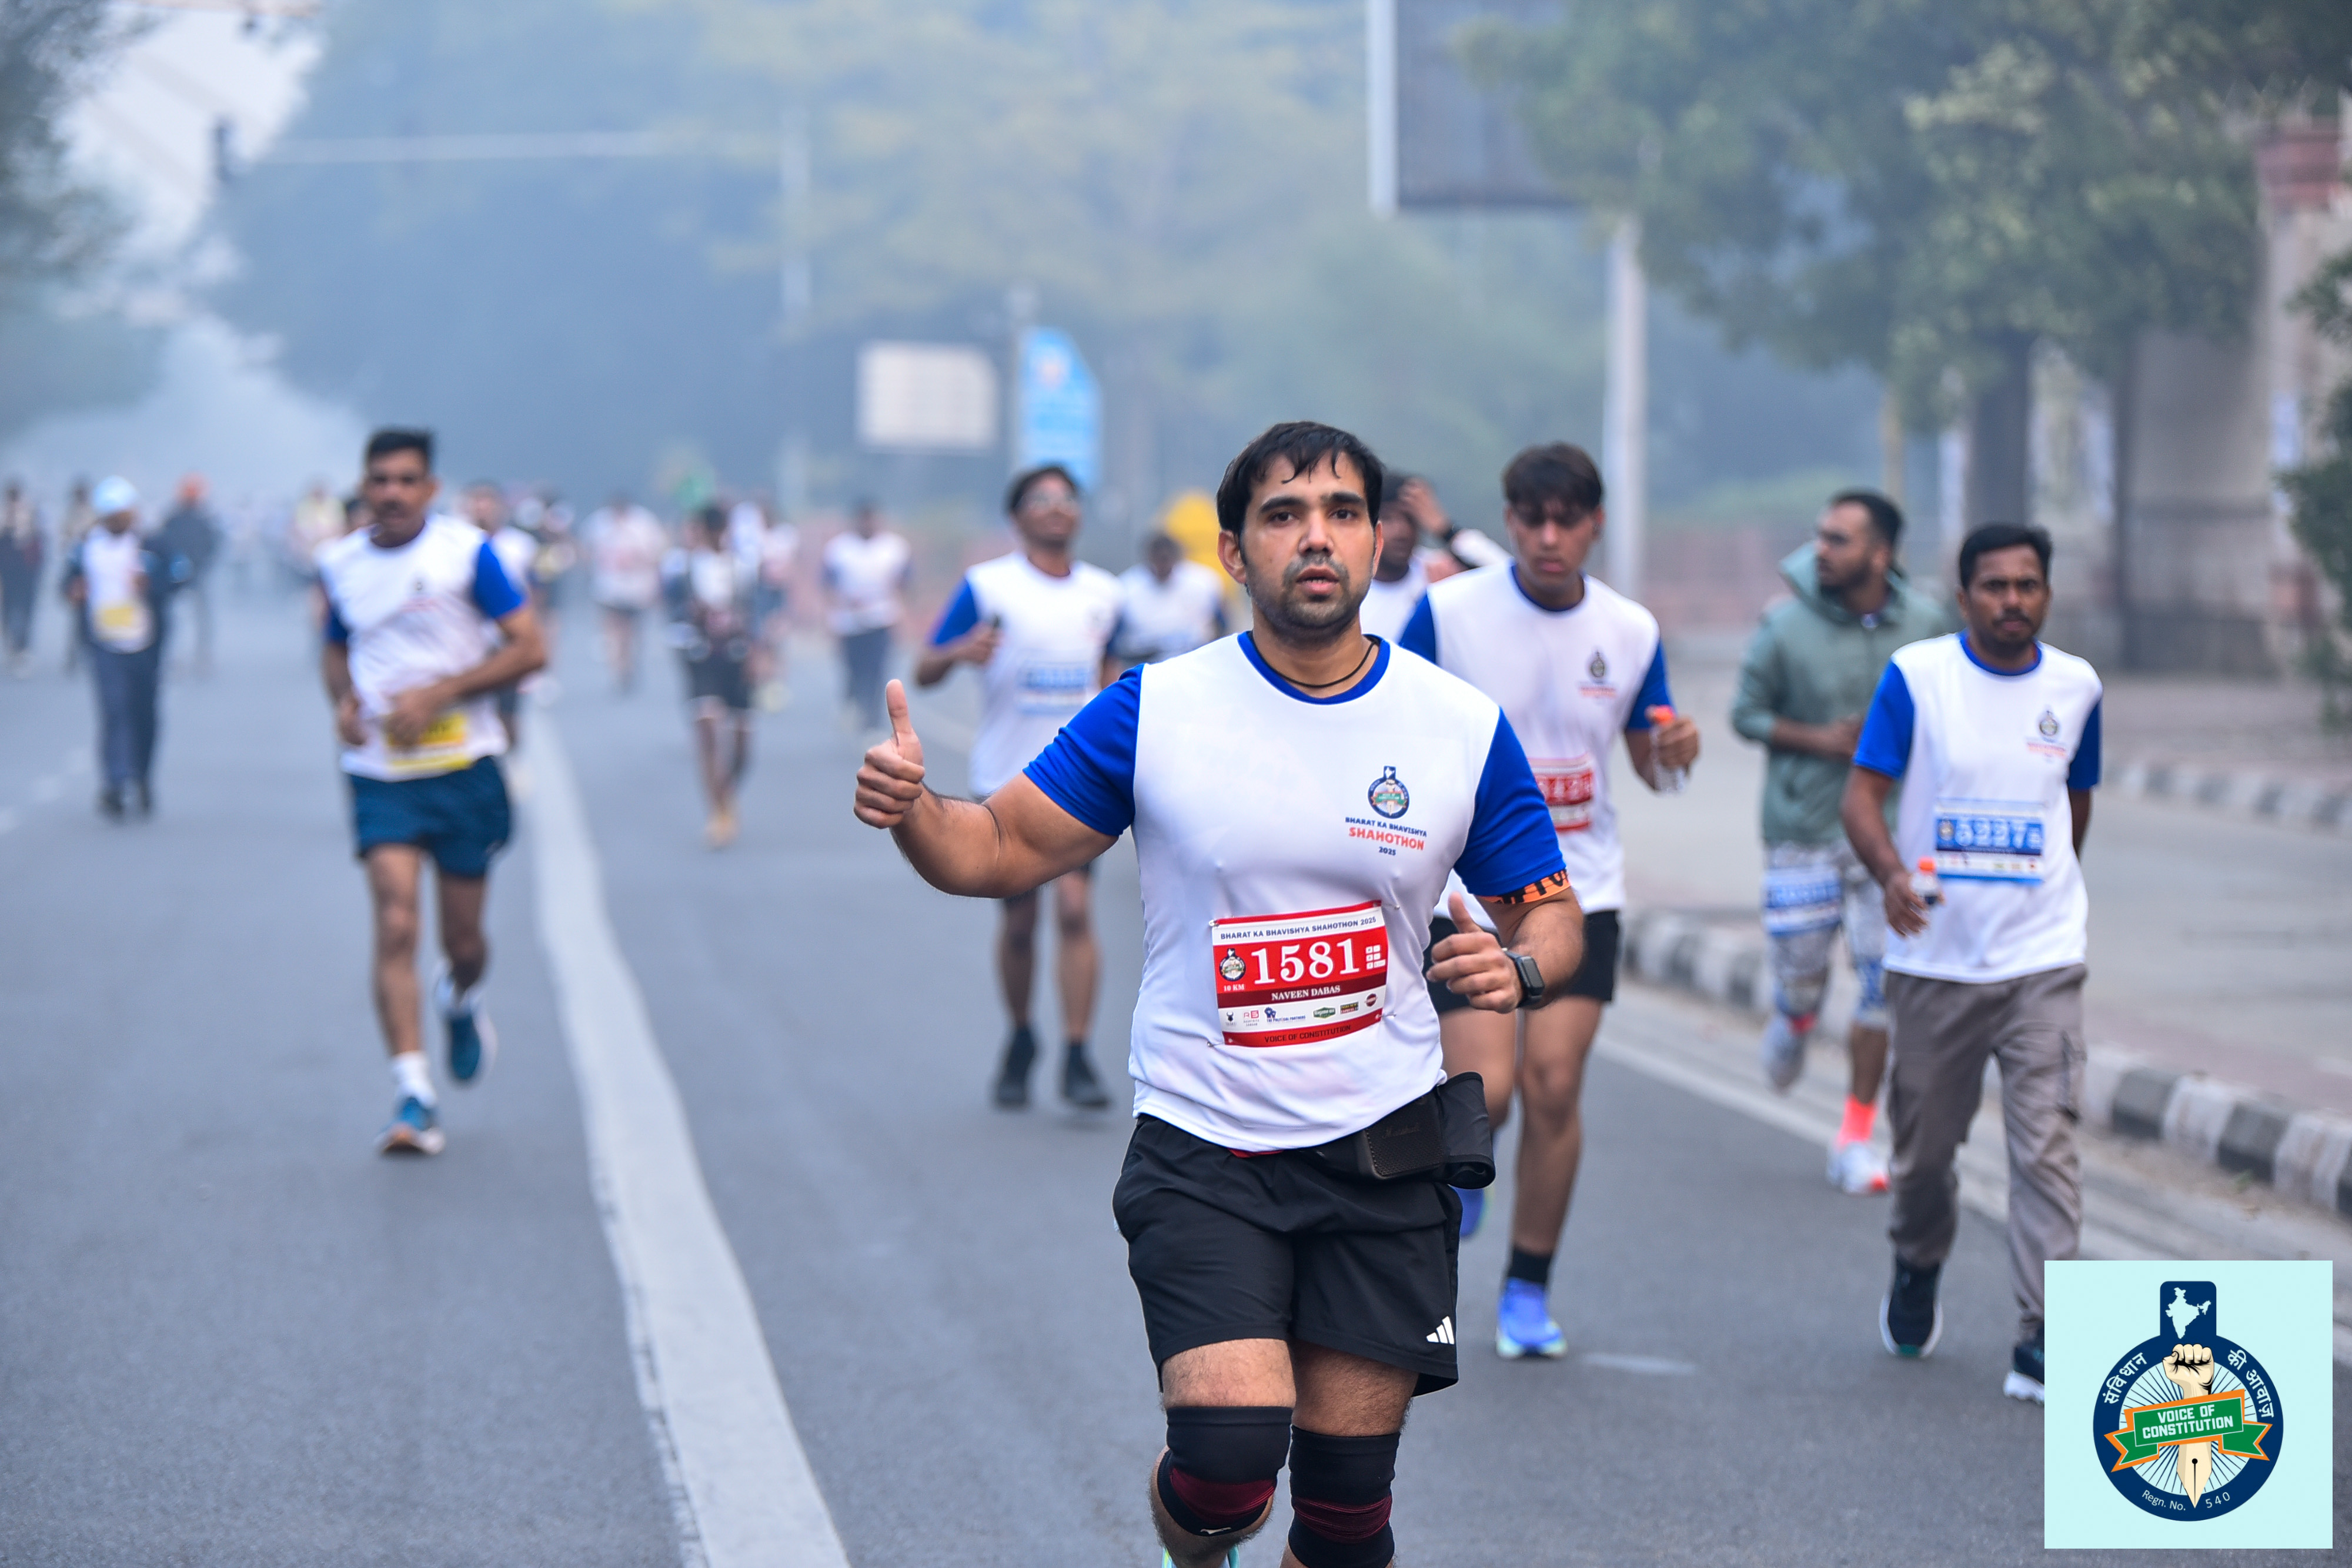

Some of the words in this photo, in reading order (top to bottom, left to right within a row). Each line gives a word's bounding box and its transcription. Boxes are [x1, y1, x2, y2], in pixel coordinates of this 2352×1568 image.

[1345, 817, 1375, 827] BHARAT
[1389, 823, 1427, 837] BHAVISHYA
[1348, 827, 1425, 851] SHAHOTHON
[1378, 846, 1396, 856] 2025
[1220, 931, 1251, 940] BHARAT
[1265, 925, 1310, 937] BHAVISHYA
[1312, 920, 1358, 932] SHAHOTHON
[1360, 916, 1377, 925] 2025
[1251, 938, 1360, 985] 1581
[1271, 989, 1309, 1001] NAVEEN
[1311, 985, 1341, 997] DABAS
[1299, 1025, 1351, 1039] CONSTITUTION
